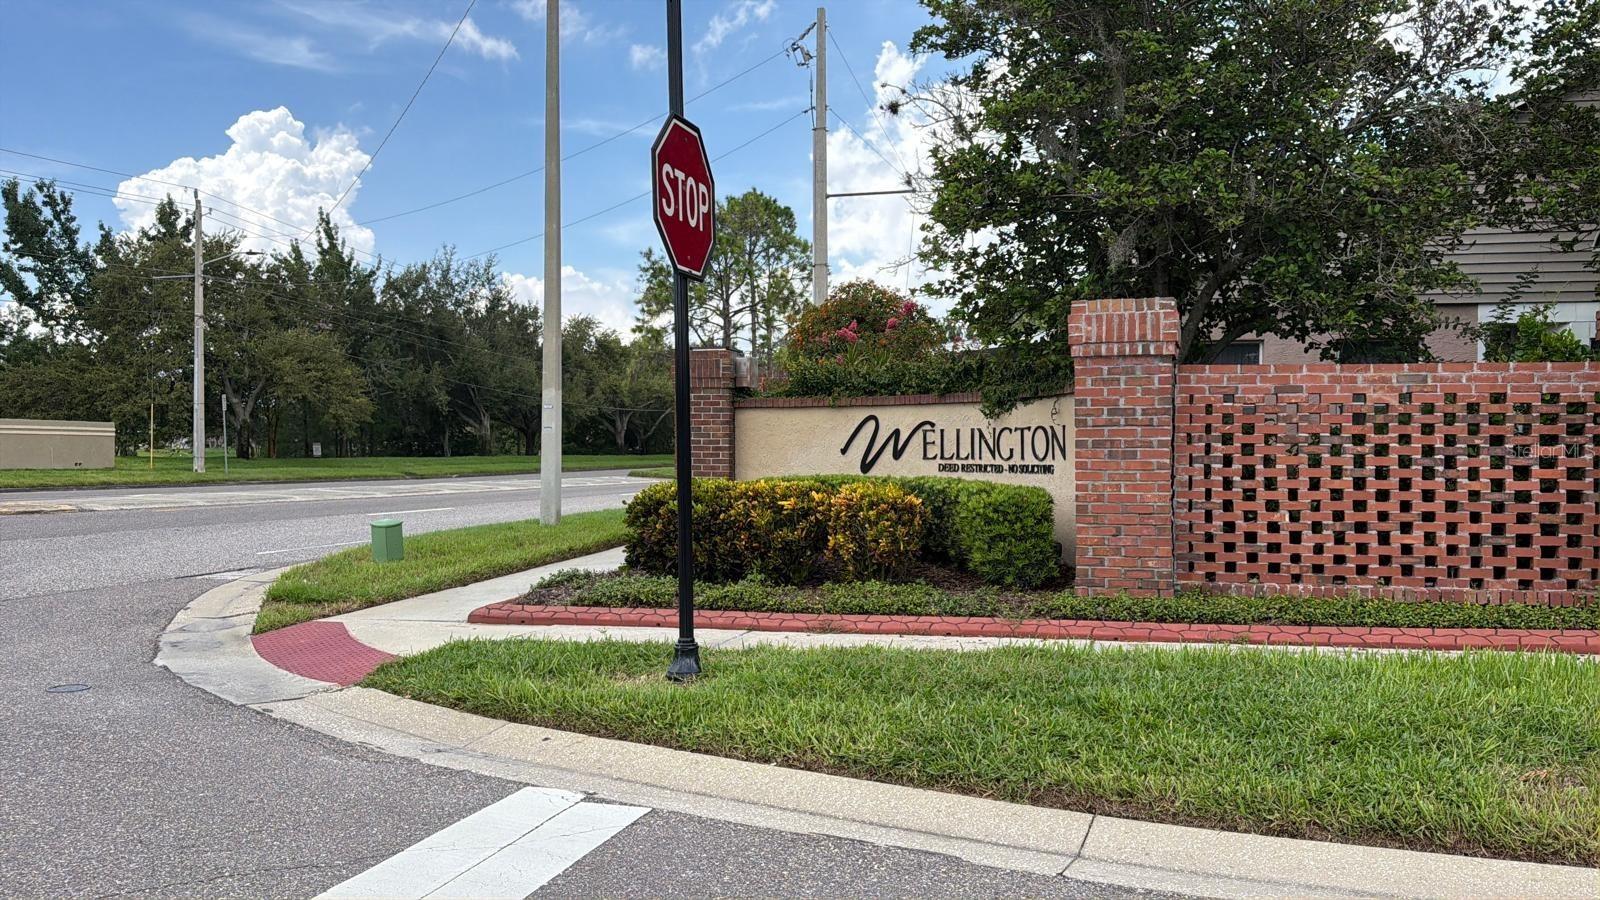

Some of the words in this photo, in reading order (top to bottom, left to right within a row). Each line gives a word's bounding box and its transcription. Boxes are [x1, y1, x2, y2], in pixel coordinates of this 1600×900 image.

[662, 163, 709, 232] STOP
[840, 414, 1066, 474] WELLINGTON
[938, 463, 960, 473] DEED
[961, 463, 1004, 474] RESTRICTED
[1008, 464, 1018, 474] NO
[1019, 464, 1055, 475] SOLICITING
